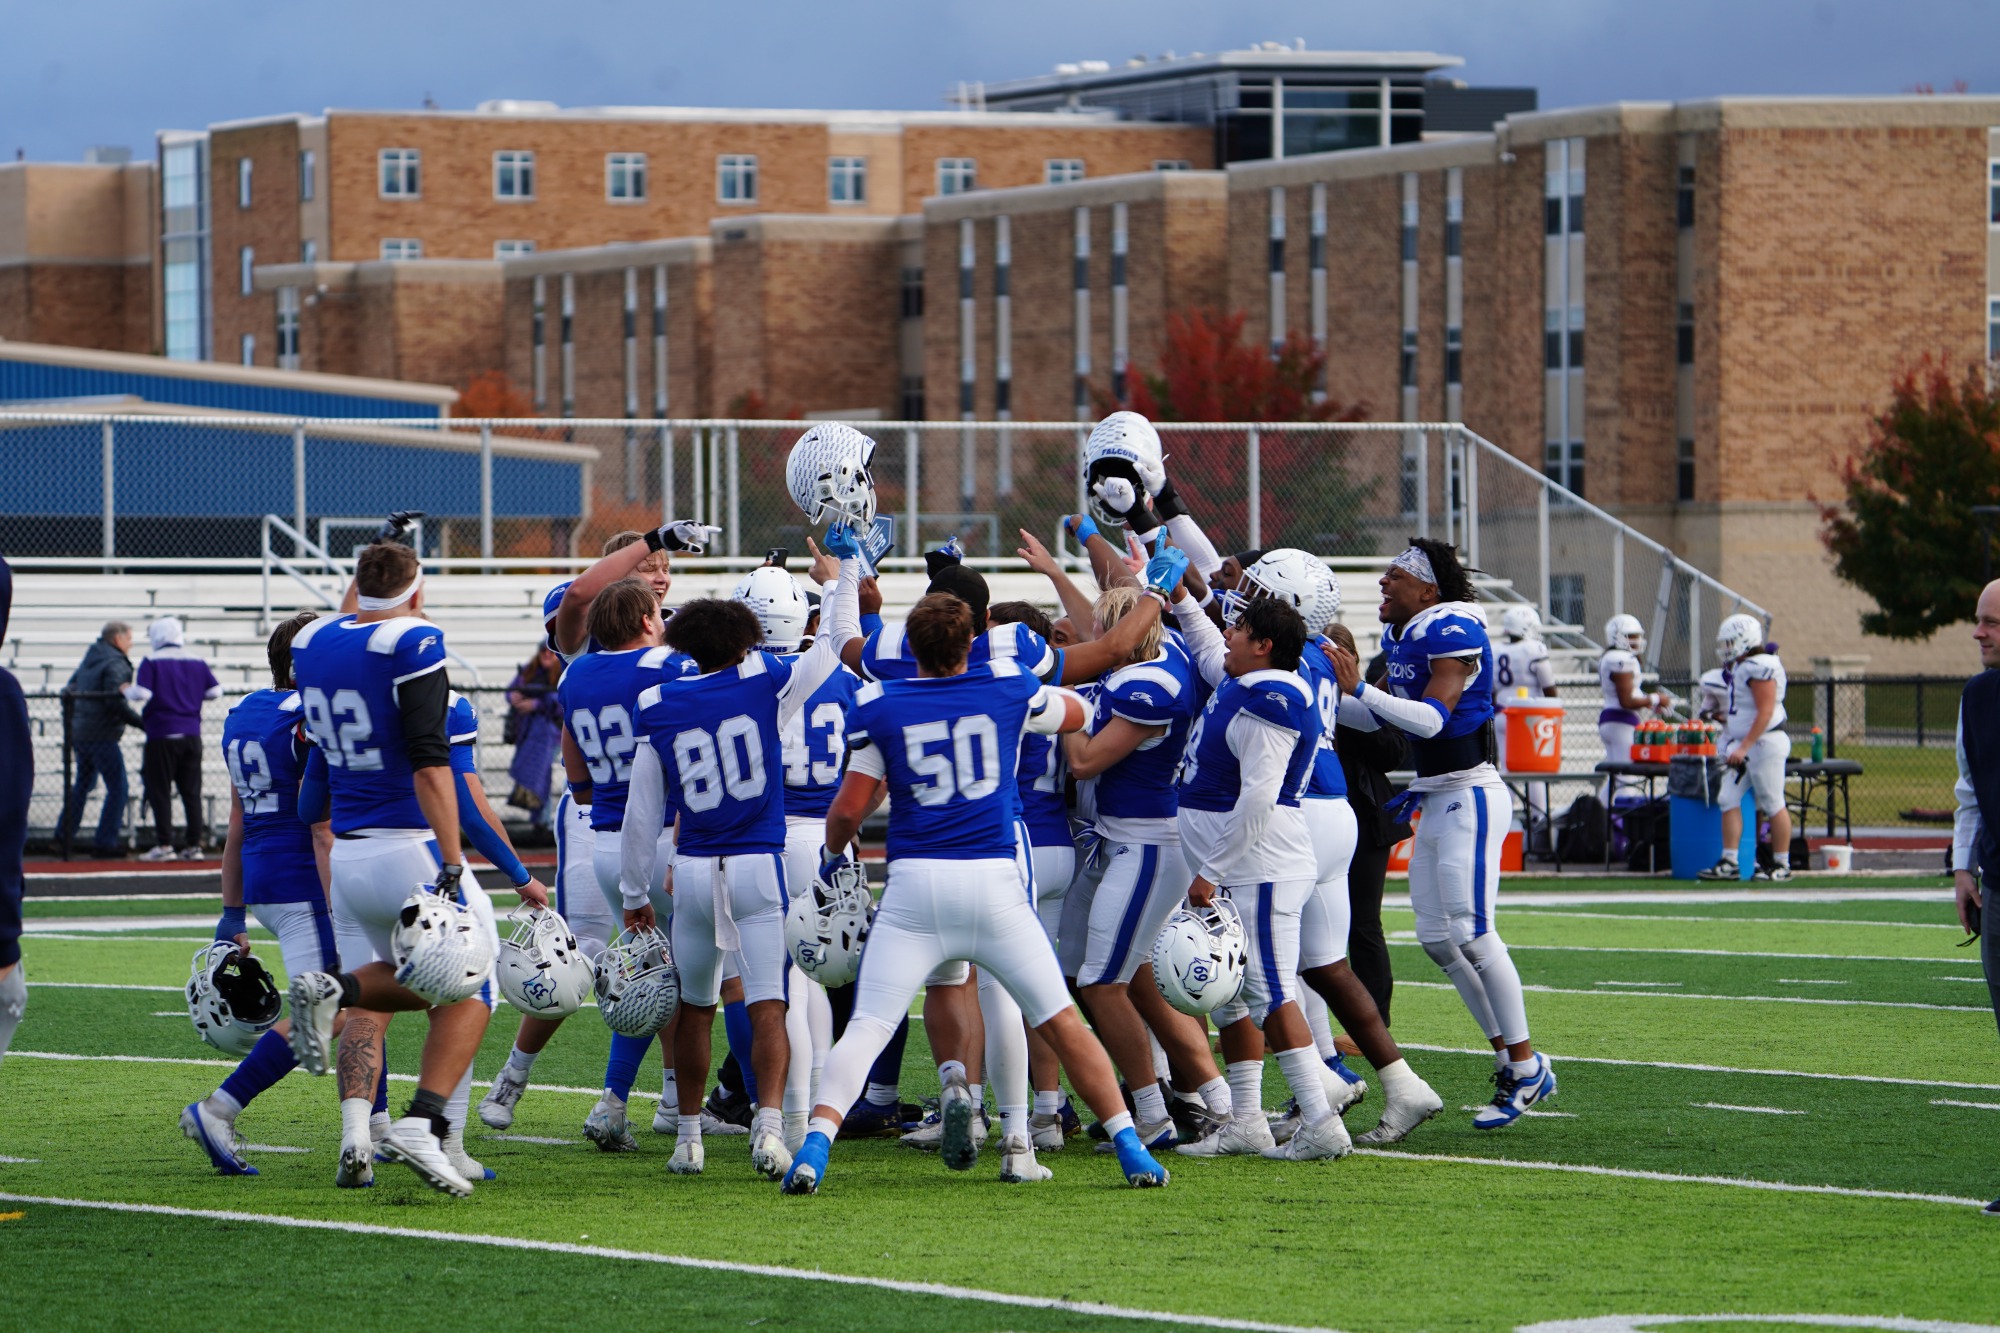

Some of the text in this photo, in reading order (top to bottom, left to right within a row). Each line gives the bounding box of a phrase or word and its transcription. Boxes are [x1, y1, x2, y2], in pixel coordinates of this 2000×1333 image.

[1101, 448, 1139, 461] FALCONS
[749, 645, 788, 653] ALCONS
[1498, 654, 1514, 687] 8
[303, 686, 384, 772] 92
[1537, 719, 1553, 739] G
[571, 704, 637, 784] 92
[781, 702, 846, 786] 43
[673, 714, 767, 814] 80
[902, 714, 1000, 806] 50
[801, 949, 816, 964] 50
[1194, 966, 1208, 982] 69
[529, 982, 550, 1000] 35
